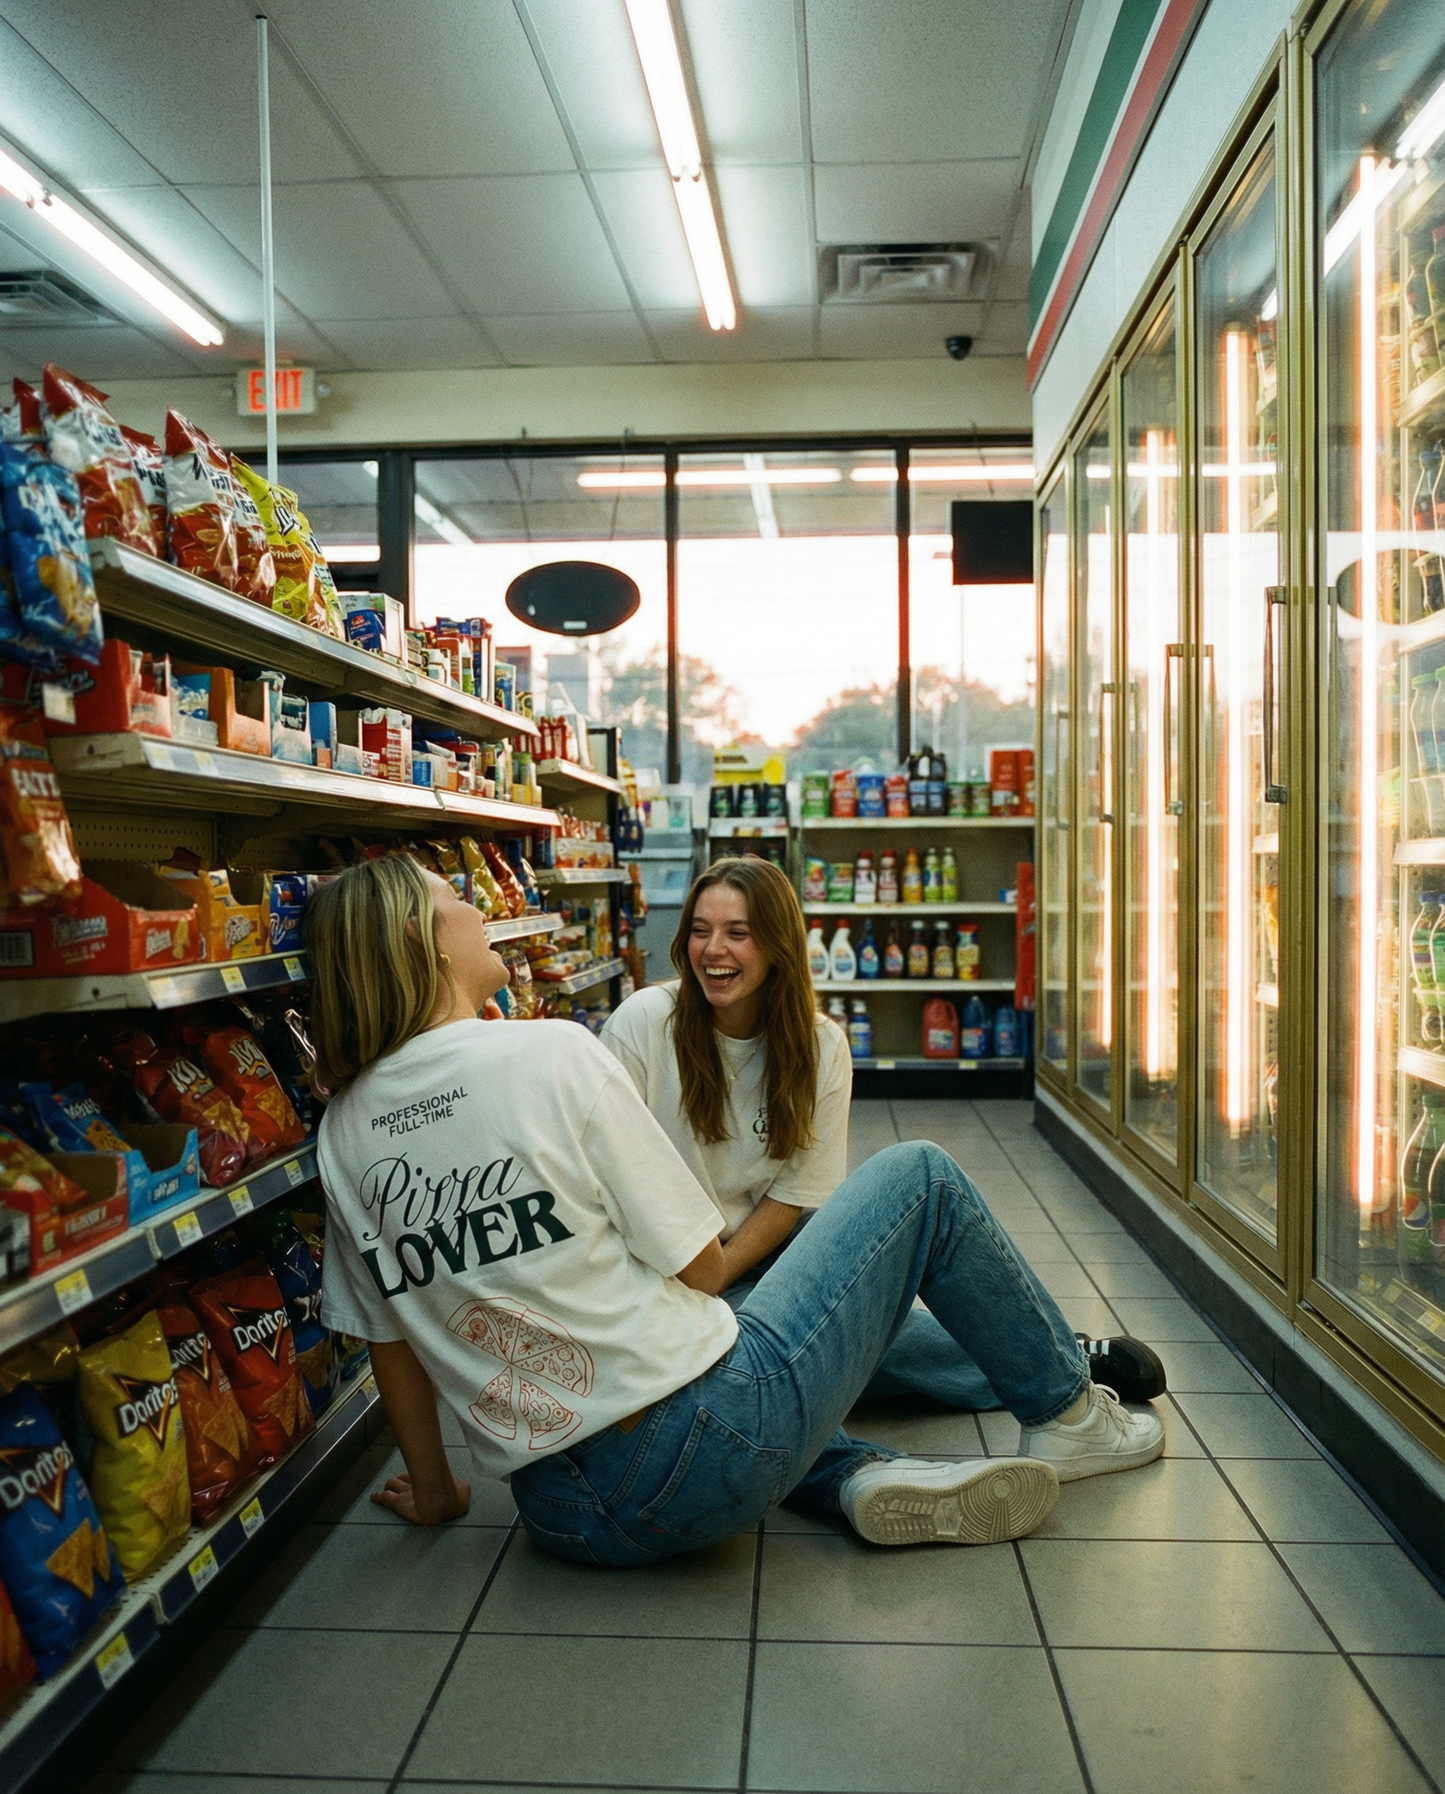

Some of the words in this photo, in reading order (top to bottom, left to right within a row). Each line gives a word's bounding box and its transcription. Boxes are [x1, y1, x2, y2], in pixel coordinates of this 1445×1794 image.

[371, 1086, 468, 1131] PROFESSIONAL
[389, 1104, 454, 1138] FULL-TIME
[359, 1151, 524, 1246] Pizza
[360, 1190, 575, 1300] LOVER
